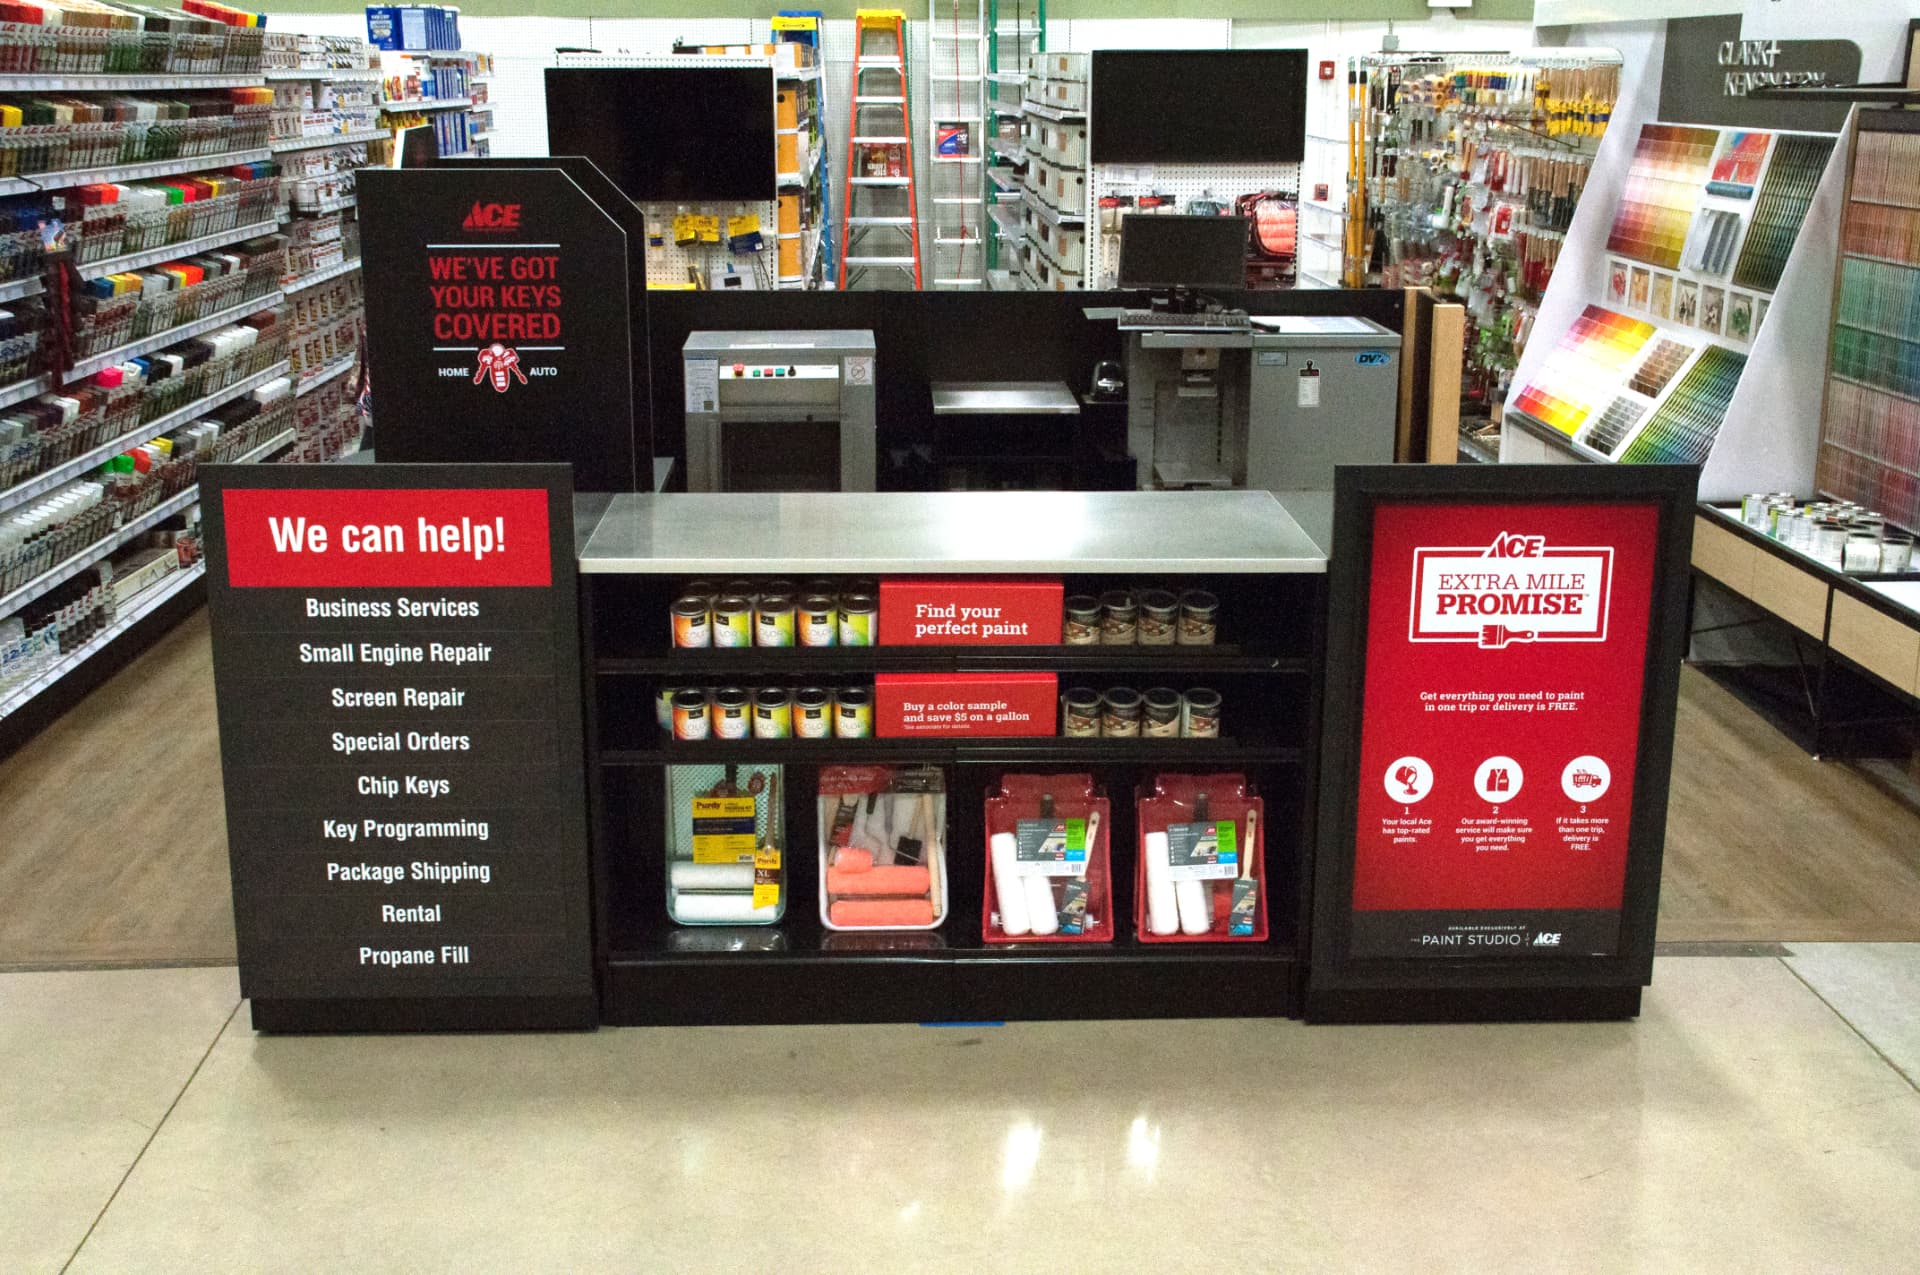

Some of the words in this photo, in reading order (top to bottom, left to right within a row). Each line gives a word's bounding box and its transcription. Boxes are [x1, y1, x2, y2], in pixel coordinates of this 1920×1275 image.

[463, 200, 521, 227] ACE
[429, 256, 504, 280] WE'VE
[511, 256, 559, 280] GOT
[430, 286, 495, 308] YOUR
[501, 285, 561, 308] KEYS
[433, 313, 561, 339] COVERED
[438, 367, 469, 377] HOME
[530, 367, 558, 377] AUTO
[269, 517, 328, 553] We
[341, 524, 405, 553] can
[417, 517, 506, 561] help!
[1488, 535, 1542, 558] ACE
[1438, 573, 1520, 590] EXTRA
[1525, 573, 1585, 590] MILE
[305, 597, 392, 618] Business
[397, 597, 480, 618] Services
[915, 603, 956, 618] Find
[960, 607, 1001, 622] your
[1436, 593, 1584, 615] PROMISE
[915, 620, 978, 638] perfect
[982, 620, 1028, 638] paint
[299, 642, 354, 663] Small
[360, 643, 424, 667] Engine
[429, 642, 492, 666] Repair
[331, 687, 398, 708] Screen
[403, 687, 466, 711] Repair
[1420, 691, 1437, 700] Get
[1440, 691, 1495, 702] everything
[1497, 693, 1516, 702] you
[1519, 691, 1543, 700] need
[1546, 692, 1555, 700] to
[1558, 691, 1584, 701] paint
[903, 702, 925, 712] Buy
[937, 701, 965, 710] color
[967, 701, 1007, 712] sample
[1425, 702, 1435, 711] in
[1459, 702, 1477, 712] trip
[1493, 702, 1534, 712] delivery
[1537, 702, 1546, 710] is
[1548, 702, 1578, 711] FREE.
[903, 713, 924, 722] and
[927, 714, 952, 722] save
[954, 712, 967, 722] $5
[331, 731, 401, 755] Special
[407, 731, 471, 751] Orders
[357, 775, 399, 799] Chip
[405, 775, 450, 799] Keys
[1404, 806, 1411, 815] 1
[1492, 805, 1499, 814] 2
[1580, 805, 1587, 814] 3
[1461, 817, 1475, 825] Our
[1476, 817, 1528, 826] award-winning
[1555, 816, 1562, 824] If
[1570, 816, 1589, 824] takes
[323, 819, 358, 843] Key
[363, 818, 489, 842] Programming
[1397, 826, 1430, 836] top-rated
[1455, 826, 1481, 834] service
[1482, 826, 1496, 834] will
[1496, 826, 1516, 834] make
[1461, 836, 1474, 845] you
[1475, 835, 1487, 844] get
[1488, 835, 1526, 844] everything
[1562, 835, 1591, 843] delivery
[1475, 845, 1489, 853] you
[327, 862, 405, 885] Package
[410, 861, 491, 884] Shipping
[381, 903, 441, 923] Rental
[1421, 934, 1464, 946] PAINT
[1467, 933, 1522, 946] STUDIO
[1532, 931, 1563, 945] ACE
[359, 946, 435, 969] Propane
[441, 945, 469, 964] Fill
